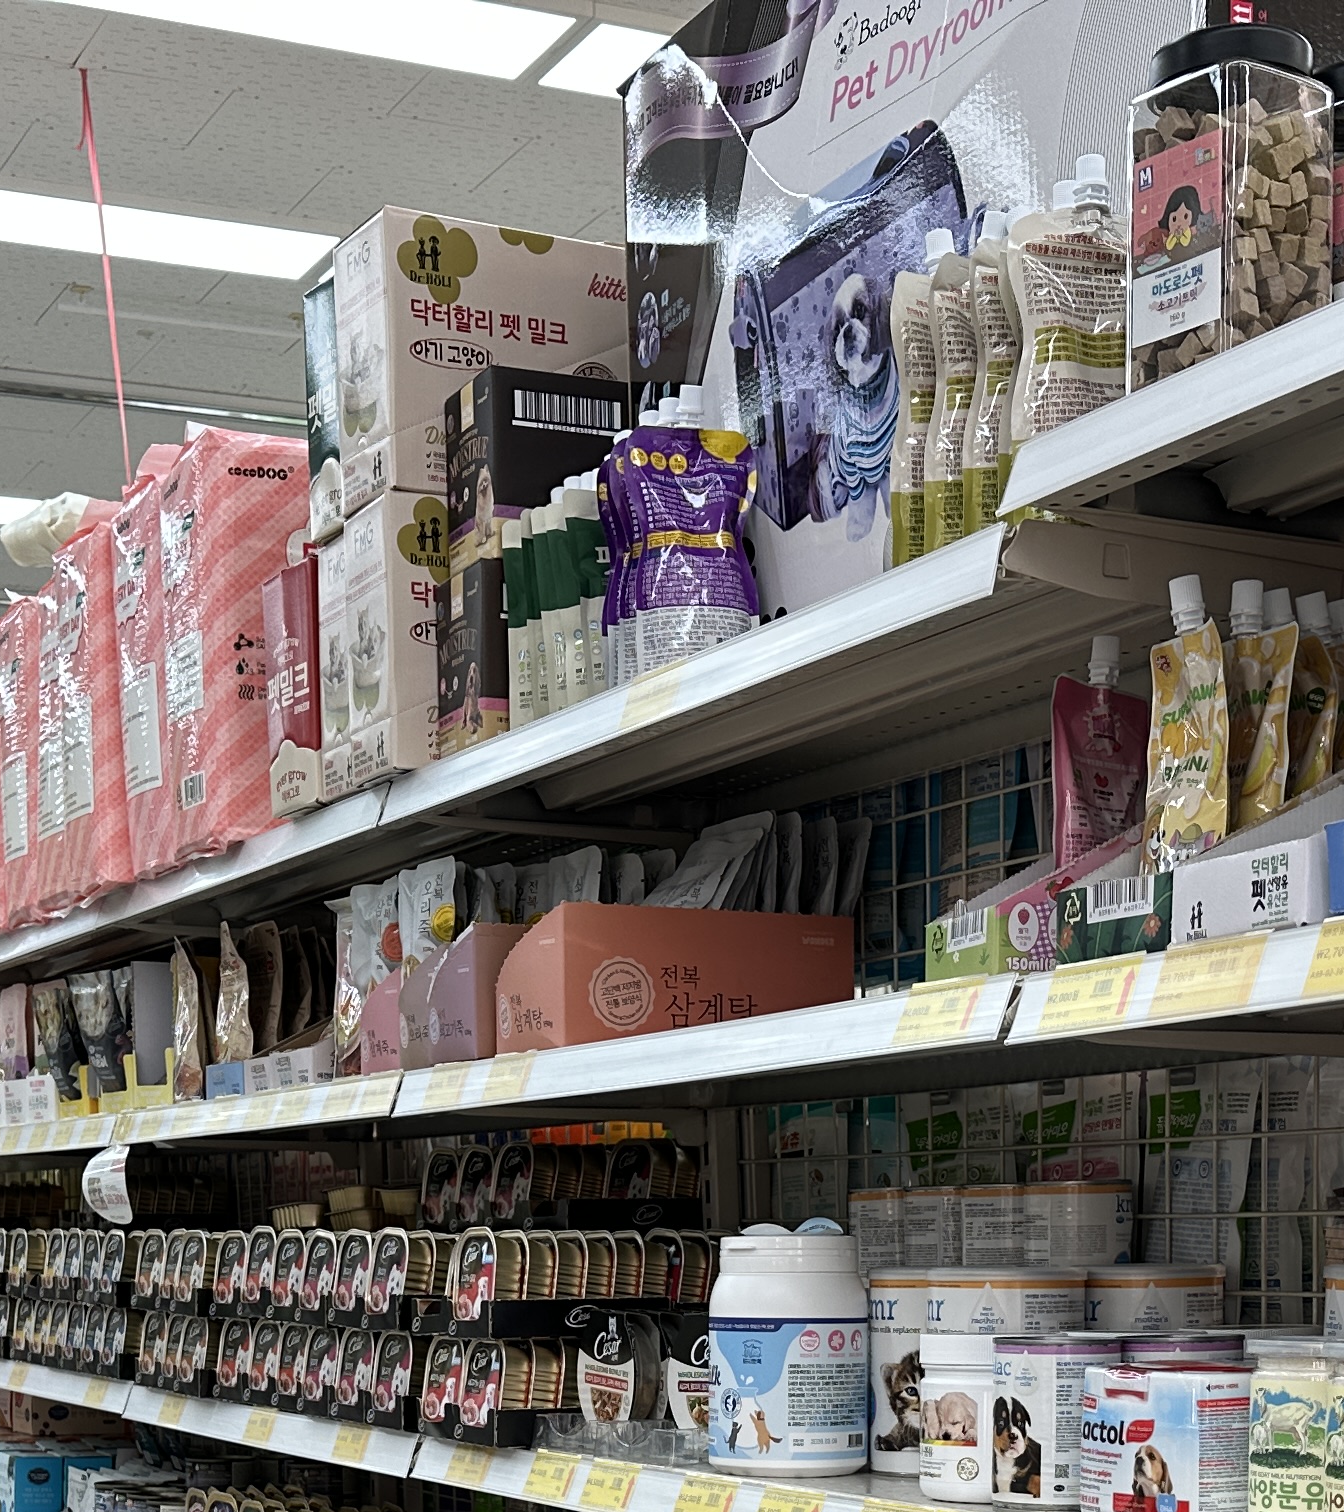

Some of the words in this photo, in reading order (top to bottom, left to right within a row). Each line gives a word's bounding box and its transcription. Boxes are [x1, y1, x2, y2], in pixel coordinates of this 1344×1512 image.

[830, 61, 878, 122] Pet
[410, 299, 494, 335] 닥터할리
[498, 312, 522, 342] 펫
[527, 318, 569, 345] 밀크
[414, 341, 443, 363] 아기
[447, 344, 491, 367] 고양이
[1251, 878, 1266, 914] 펫
[660, 962, 701, 991] 전복
